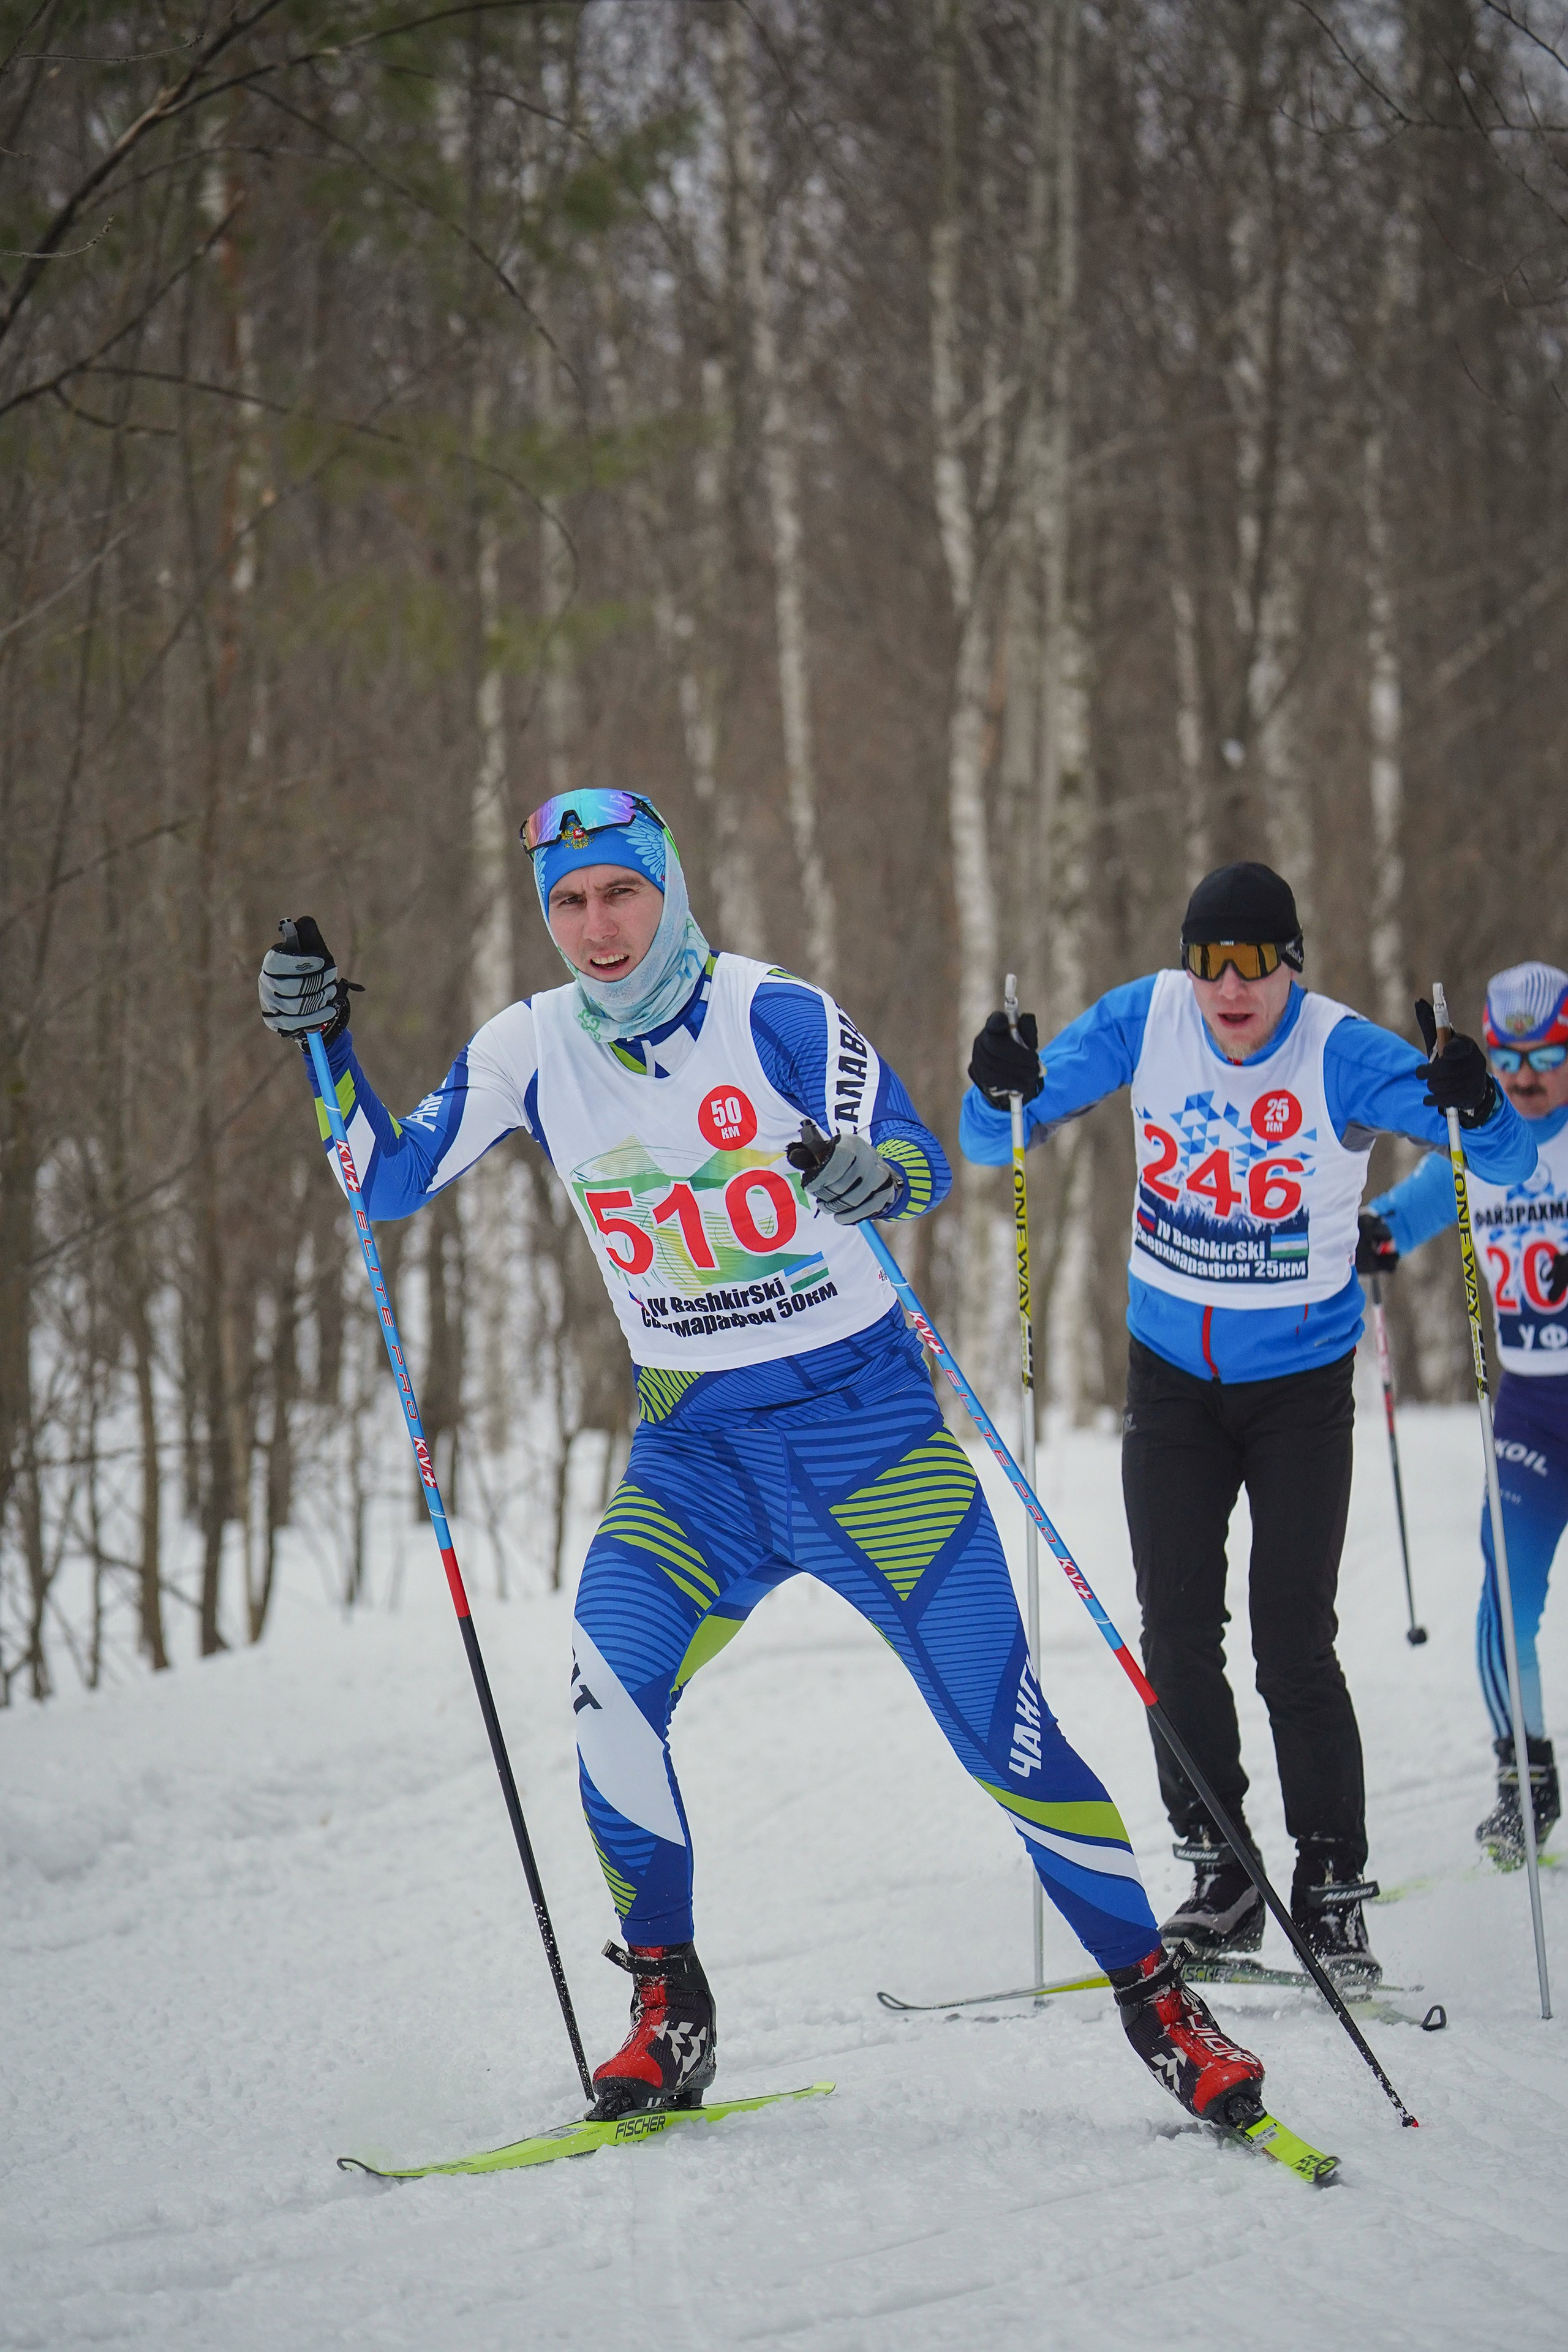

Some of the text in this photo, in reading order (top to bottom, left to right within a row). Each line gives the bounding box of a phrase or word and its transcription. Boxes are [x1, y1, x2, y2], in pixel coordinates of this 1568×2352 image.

[710, 1096, 742, 1127] 50
[1264, 1098, 1290, 1121] 25
[1142, 1124, 1305, 1219] 246
[585, 1169, 797, 1275] 510
[1474, 1199, 1568, 1228] ФАЙЗРАХМ
[1156, 1218, 1266, 1261] IV BashkirSki
[356, 1208, 394, 1329] ELITE
[390, 1344, 418, 1420] PRO
[647, 1276, 786, 1317] IV BashkirSki
[944, 1368, 1011, 1467] ELITE
[1012, 1480, 1057, 1545] PRO
[1176, 1849, 1219, 1861] MADSHUS
[615, 2115, 666, 2139] FISCHER
